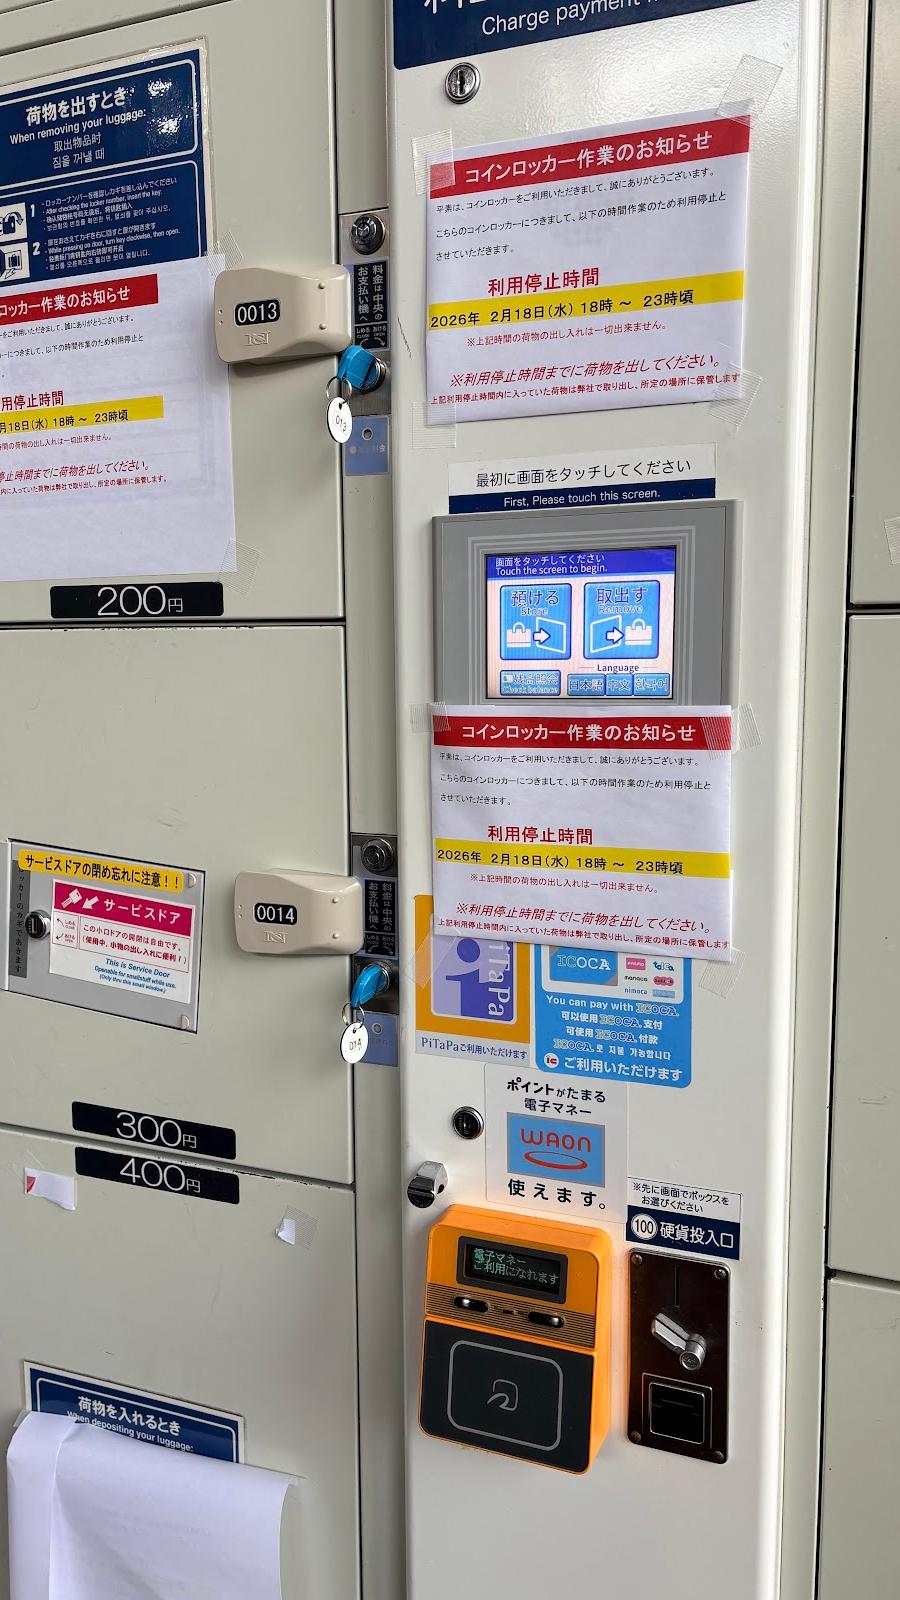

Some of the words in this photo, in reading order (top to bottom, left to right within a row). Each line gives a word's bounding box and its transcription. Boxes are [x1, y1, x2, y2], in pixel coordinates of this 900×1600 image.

[482, 10, 550, 35] Charge
[26, 86, 128, 126] 荷物を出すとき
[10, 132, 35, 145] When
[37, 122, 80, 139] removing
[82, 117, 103, 133] your
[105, 109, 146, 126] luggage:
[54, 133, 101, 152] 取出物品时
[52, 155, 70, 169] 짐을
[73, 151, 93, 165] 꺼낼
[95, 148, 105, 160] 때
[465, 130, 714, 185] コインロッカー作業のお知らせ
[436, 167, 715, 213] 平素は、コインロッカーをご利用いただきまして、誠にありがとうございます。
[30, 204, 35, 217] 1
[58, 204, 79, 213] checking
[89, 198, 105, 208] locker
[436, 191, 727, 239] こちらのコインロッカーにつきまして、以下の時間作業のため利用停止と
[32, 242, 41, 256] 2
[62, 243, 83, 252] pressing
[153, 230, 164, 238] then
[165, 228, 180, 236] open.
[435, 244, 516, 261] させていただきます。
[373, 264, 384, 320] 料金は中央の
[488, 267, 600, 297] 利用停止時間
[358, 267, 369, 320] お支払い機へ
[237, 302, 278, 323] 0013
[430, 311, 481, 328] 2026年
[581, 299, 612, 314] 18時
[643, 289, 694, 308] 23時頃
[467, 320, 667, 347] ※上記時間の荷物の出し入れは一切出来ません。
[0, 335, 144, 358] ーにつきまして、以下の時間作業のため利用停止と
[450, 353, 721, 388] ※利用停止時間までに荷物を出してください。
[53, 414, 74, 427] 18時
[95, 409, 128, 424] 23時頃
[0, 434, 112, 450] 間の荷物の出し入れは一切出来ません。
[476, 459, 691, 488] 最初に画面をタッチしてください
[503, 497, 529, 508] First,
[532, 495, 565, 506] Please
[568, 492, 597, 503] touch
[600, 490, 619, 500] this
[622, 488, 660, 499] screen.
[495, 554, 605, 567] 画面をタッチしてください
[496, 567, 521, 576] Touch
[523, 566, 537, 574] the
[581, 564, 608, 573] begin.
[97, 585, 183, 616] 200円
[512, 590, 559, 607] 預ける
[597, 587, 647, 604] 取出す
[521, 607, 548, 615] Store
[599, 604, 643, 614] Remove
[597, 664, 640, 673] Language
[570, 679, 603, 690] 日本語
[462, 724, 696, 741] コインロッカー作業のお知らせ
[440, 752, 699, 766] 平素は、コインロッカーをご利用いただきまして、誠にありがとうございます。
[440, 775, 711, 790] こちらのコインロッカーにつきまして、以下の時間作業のため利用停止と
[440, 794, 511, 805] させていただきます。
[488, 825, 593, 845] 利用停止時間
[437, 850, 481, 862] 2026年
[576, 857, 606, 870] 18時
[636, 860, 683, 874] 23時頃
[470, 874, 658, 893] ※上記時間の荷物の出し入れは一切出来ません。
[104, 899, 181, 924] サービスドア
[257, 905, 295, 923] 0014
[369, 883, 379, 929] お支払い機へ
[383, 883, 392, 931] 料金は中央の
[15, 870, 24, 972] ッカーのカギであきます
[457, 903, 711, 934] ※利用停止時間までに荷物を出してください。
[95, 966, 118, 975] Openable
[106, 958, 119, 967] This
[129, 963, 153, 974] Service
[154, 969, 170, 977] Door
[557, 954, 611, 971] ICOCA
[546, 995, 566, 1004] You
[569, 999, 586, 1007] can
[612, 1003, 633, 1011] with
[561, 1011, 598, 1023] 可以使用
[644, 1020, 663, 1030] 支付
[566, 1027, 593, 1036] 可使用
[639, 1035, 658, 1045] 付款
[421, 1037, 528, 1060] PiTaPaご利用いただけます
[630, 1048, 671, 1060] 가능합니다
[564, 1057, 682, 1081] ご利用いただけます
[507, 1077, 606, 1103] ポイントがたまる
[524, 1098, 592, 1116] 電子マネー
[116, 1112, 196, 1148] 300円
[520, 1127, 591, 1152] WAON
[120, 1158, 200, 1193] 400円
[508, 1179, 606, 1210] 使えます。
[633, 1182, 729, 1205] ※先に画面でボックスを
[641, 1196, 703, 1213] お選びください
[634, 1218, 654, 1234] 100
[660, 1221, 733, 1249] 硬貨投入口
[473, 1247, 527, 1264] 電子マネー
[473, 1261, 559, 1285] ご利用になれます
[78, 1396, 181, 1436] 荷物を入れるとき
[91, 1418, 134, 1437] depositing
[137, 1430, 155, 1441] your
[157, 1436, 194, 1452] luggage:
